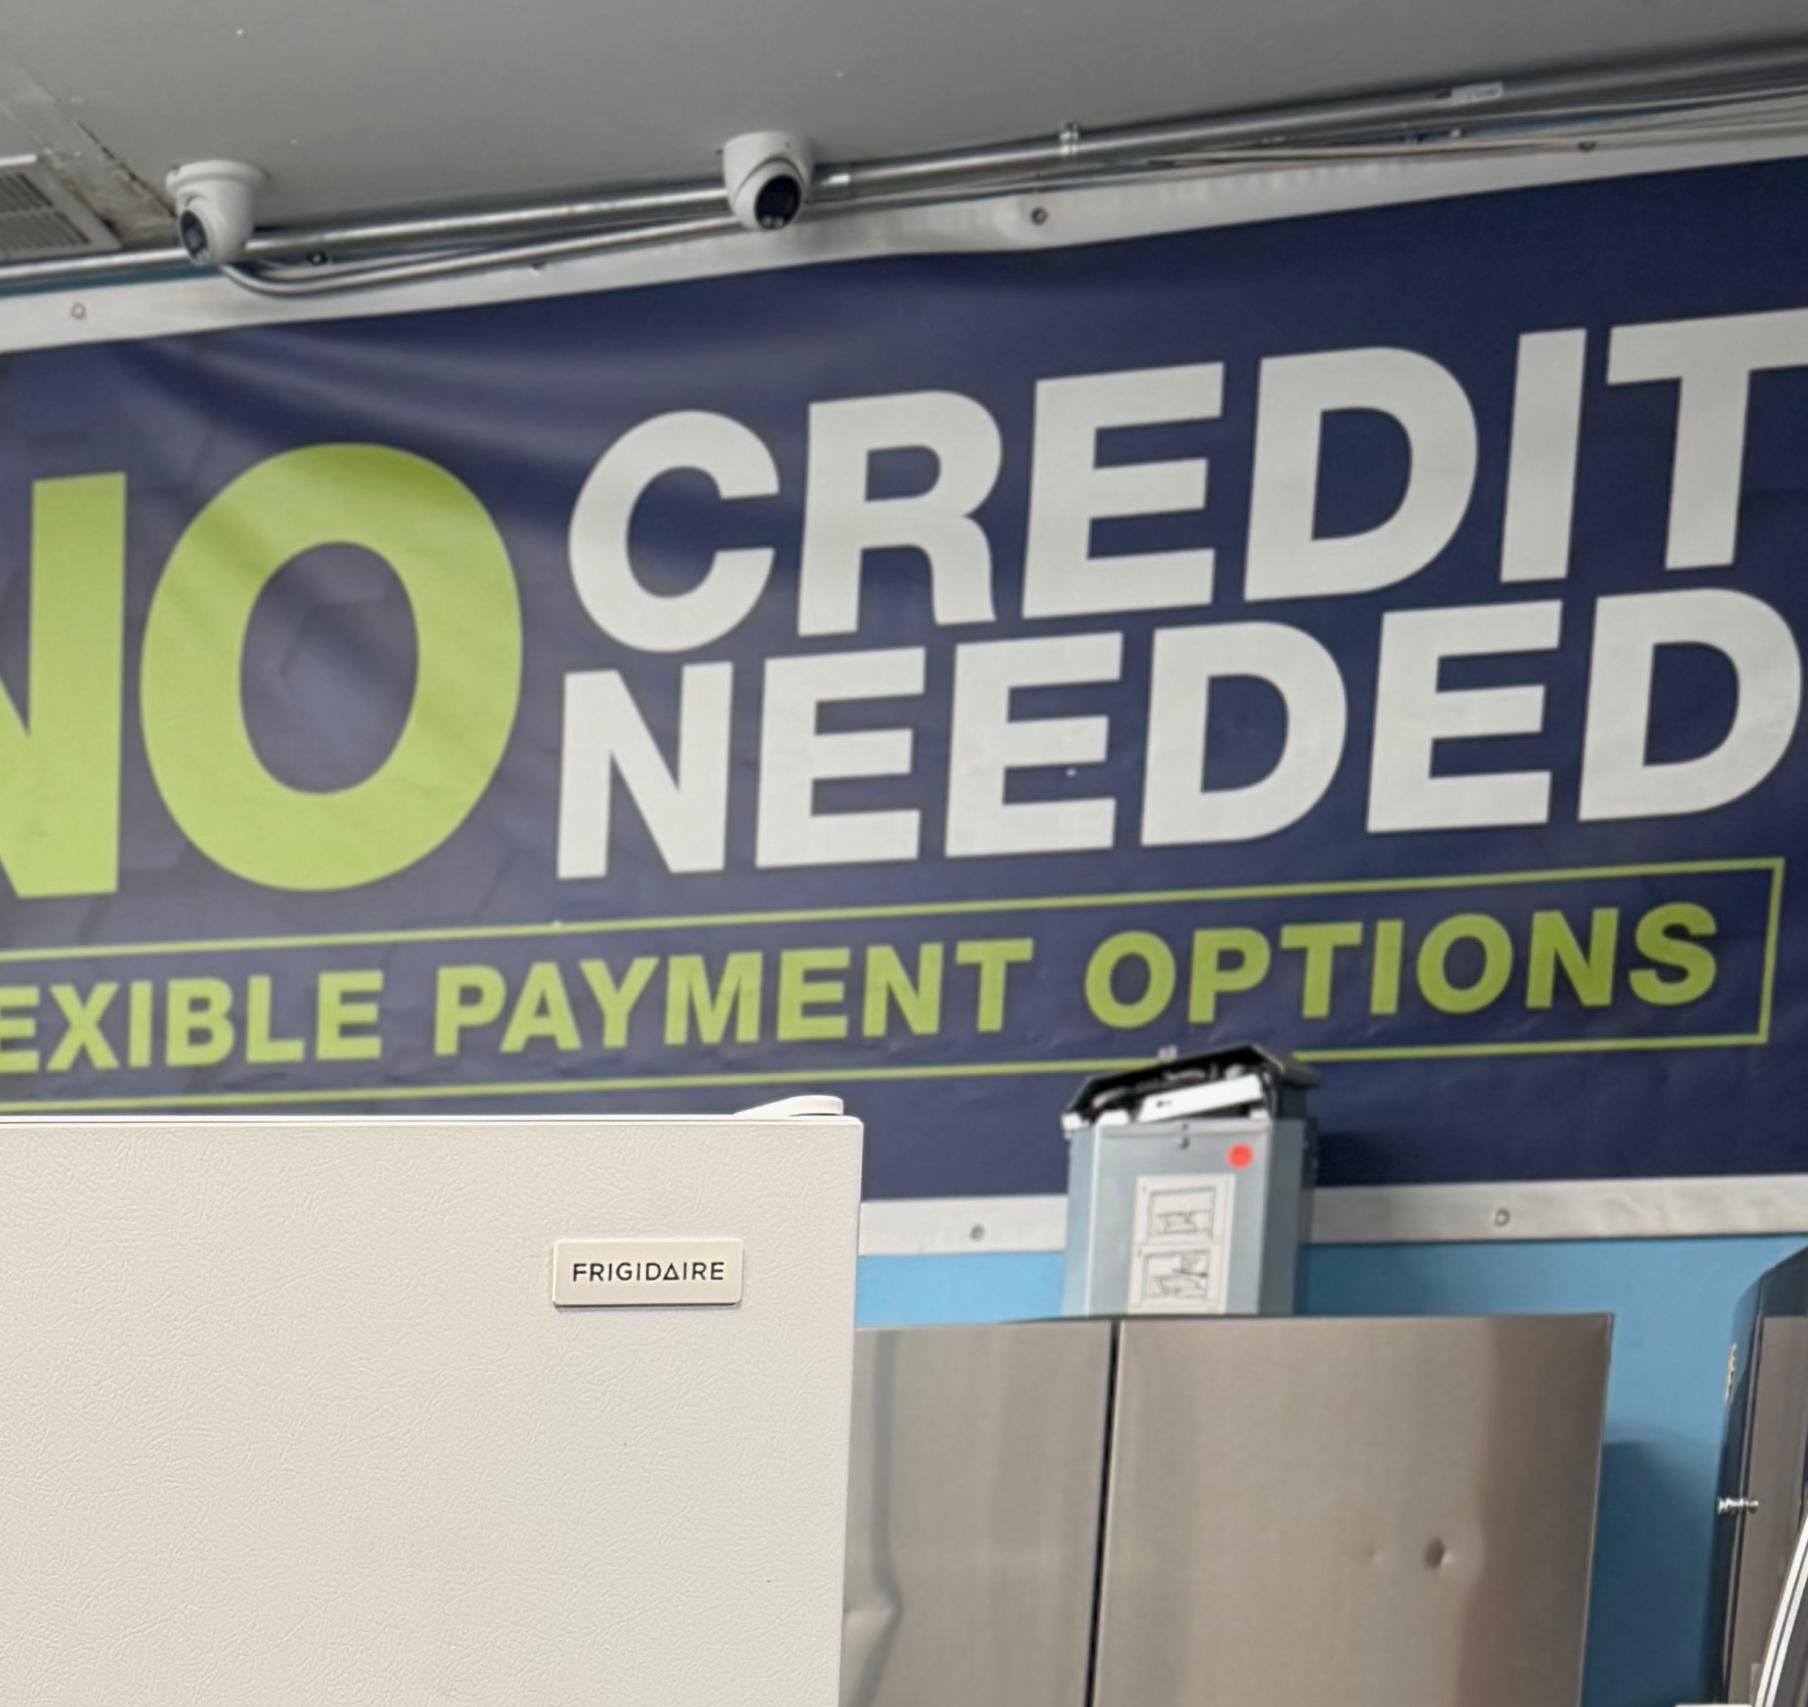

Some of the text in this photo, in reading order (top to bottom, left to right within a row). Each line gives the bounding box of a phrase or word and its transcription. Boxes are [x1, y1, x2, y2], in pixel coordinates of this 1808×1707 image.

[568, 308, 1808, 653] CREDIT
[556, 588, 1803, 879] NEEDED
[434, 937, 1033, 1057] PAYMENT
[1084, 902, 1720, 1030] OPTIONS
[572, 1261, 725, 1282] FRIGIDAIRE
